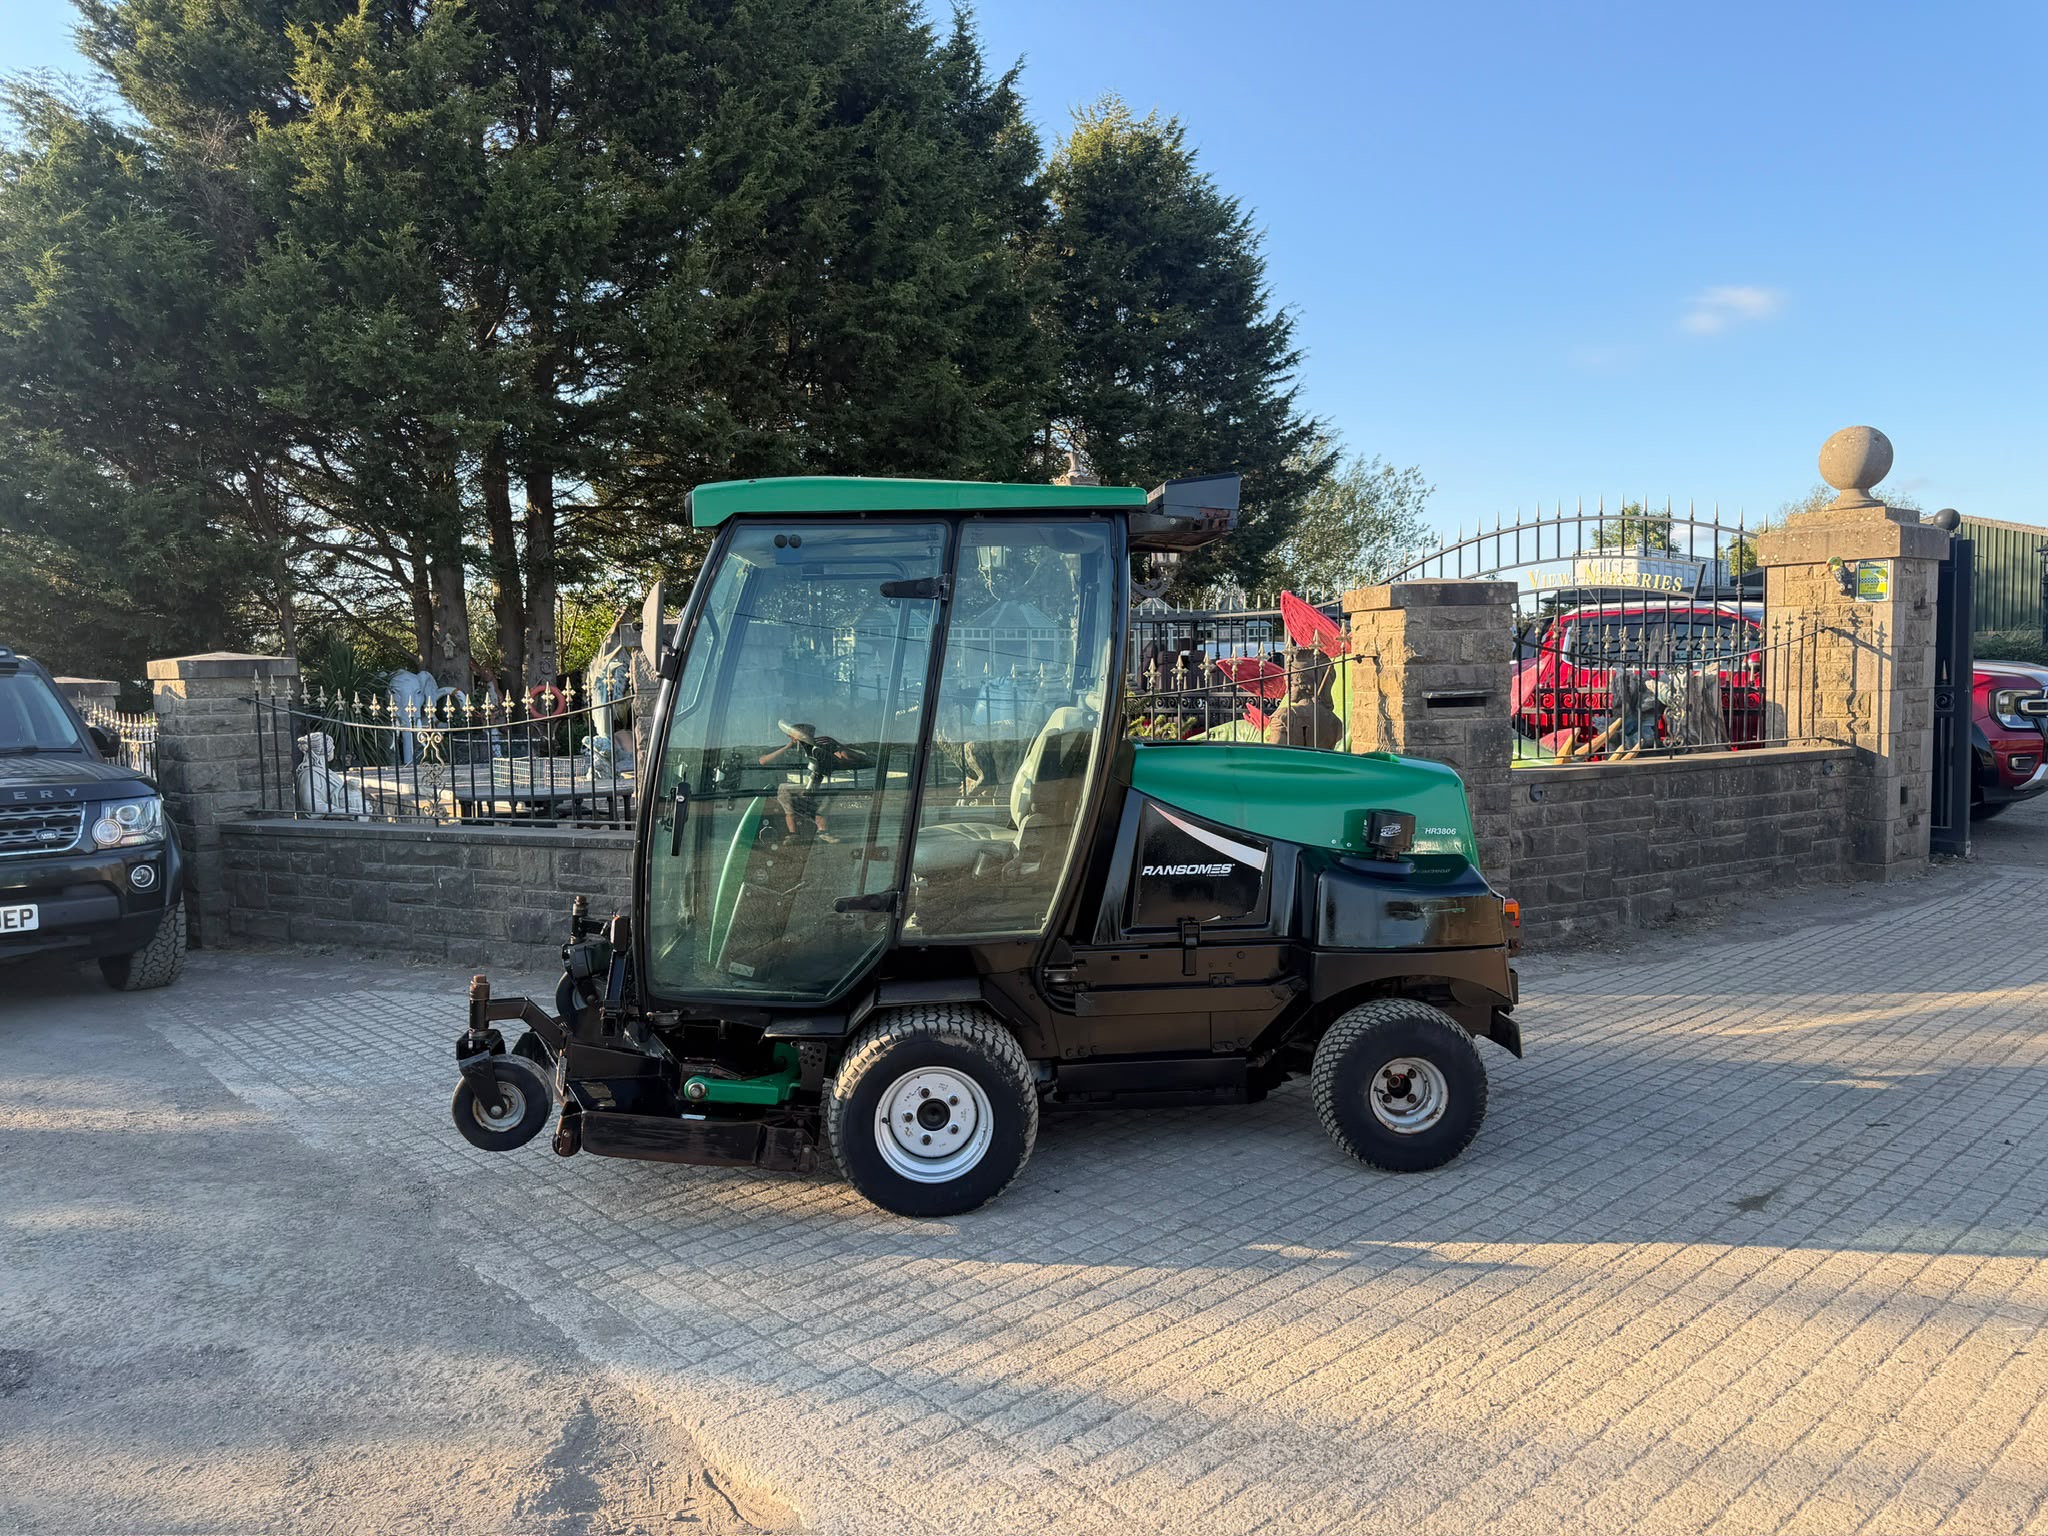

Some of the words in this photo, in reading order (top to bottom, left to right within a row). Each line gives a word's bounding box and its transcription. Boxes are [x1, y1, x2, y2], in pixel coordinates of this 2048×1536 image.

[1425, 827, 1457, 836] HR3806
[1142, 863, 1232, 876] RANSOMES
[0, 908, 34, 929] EP
